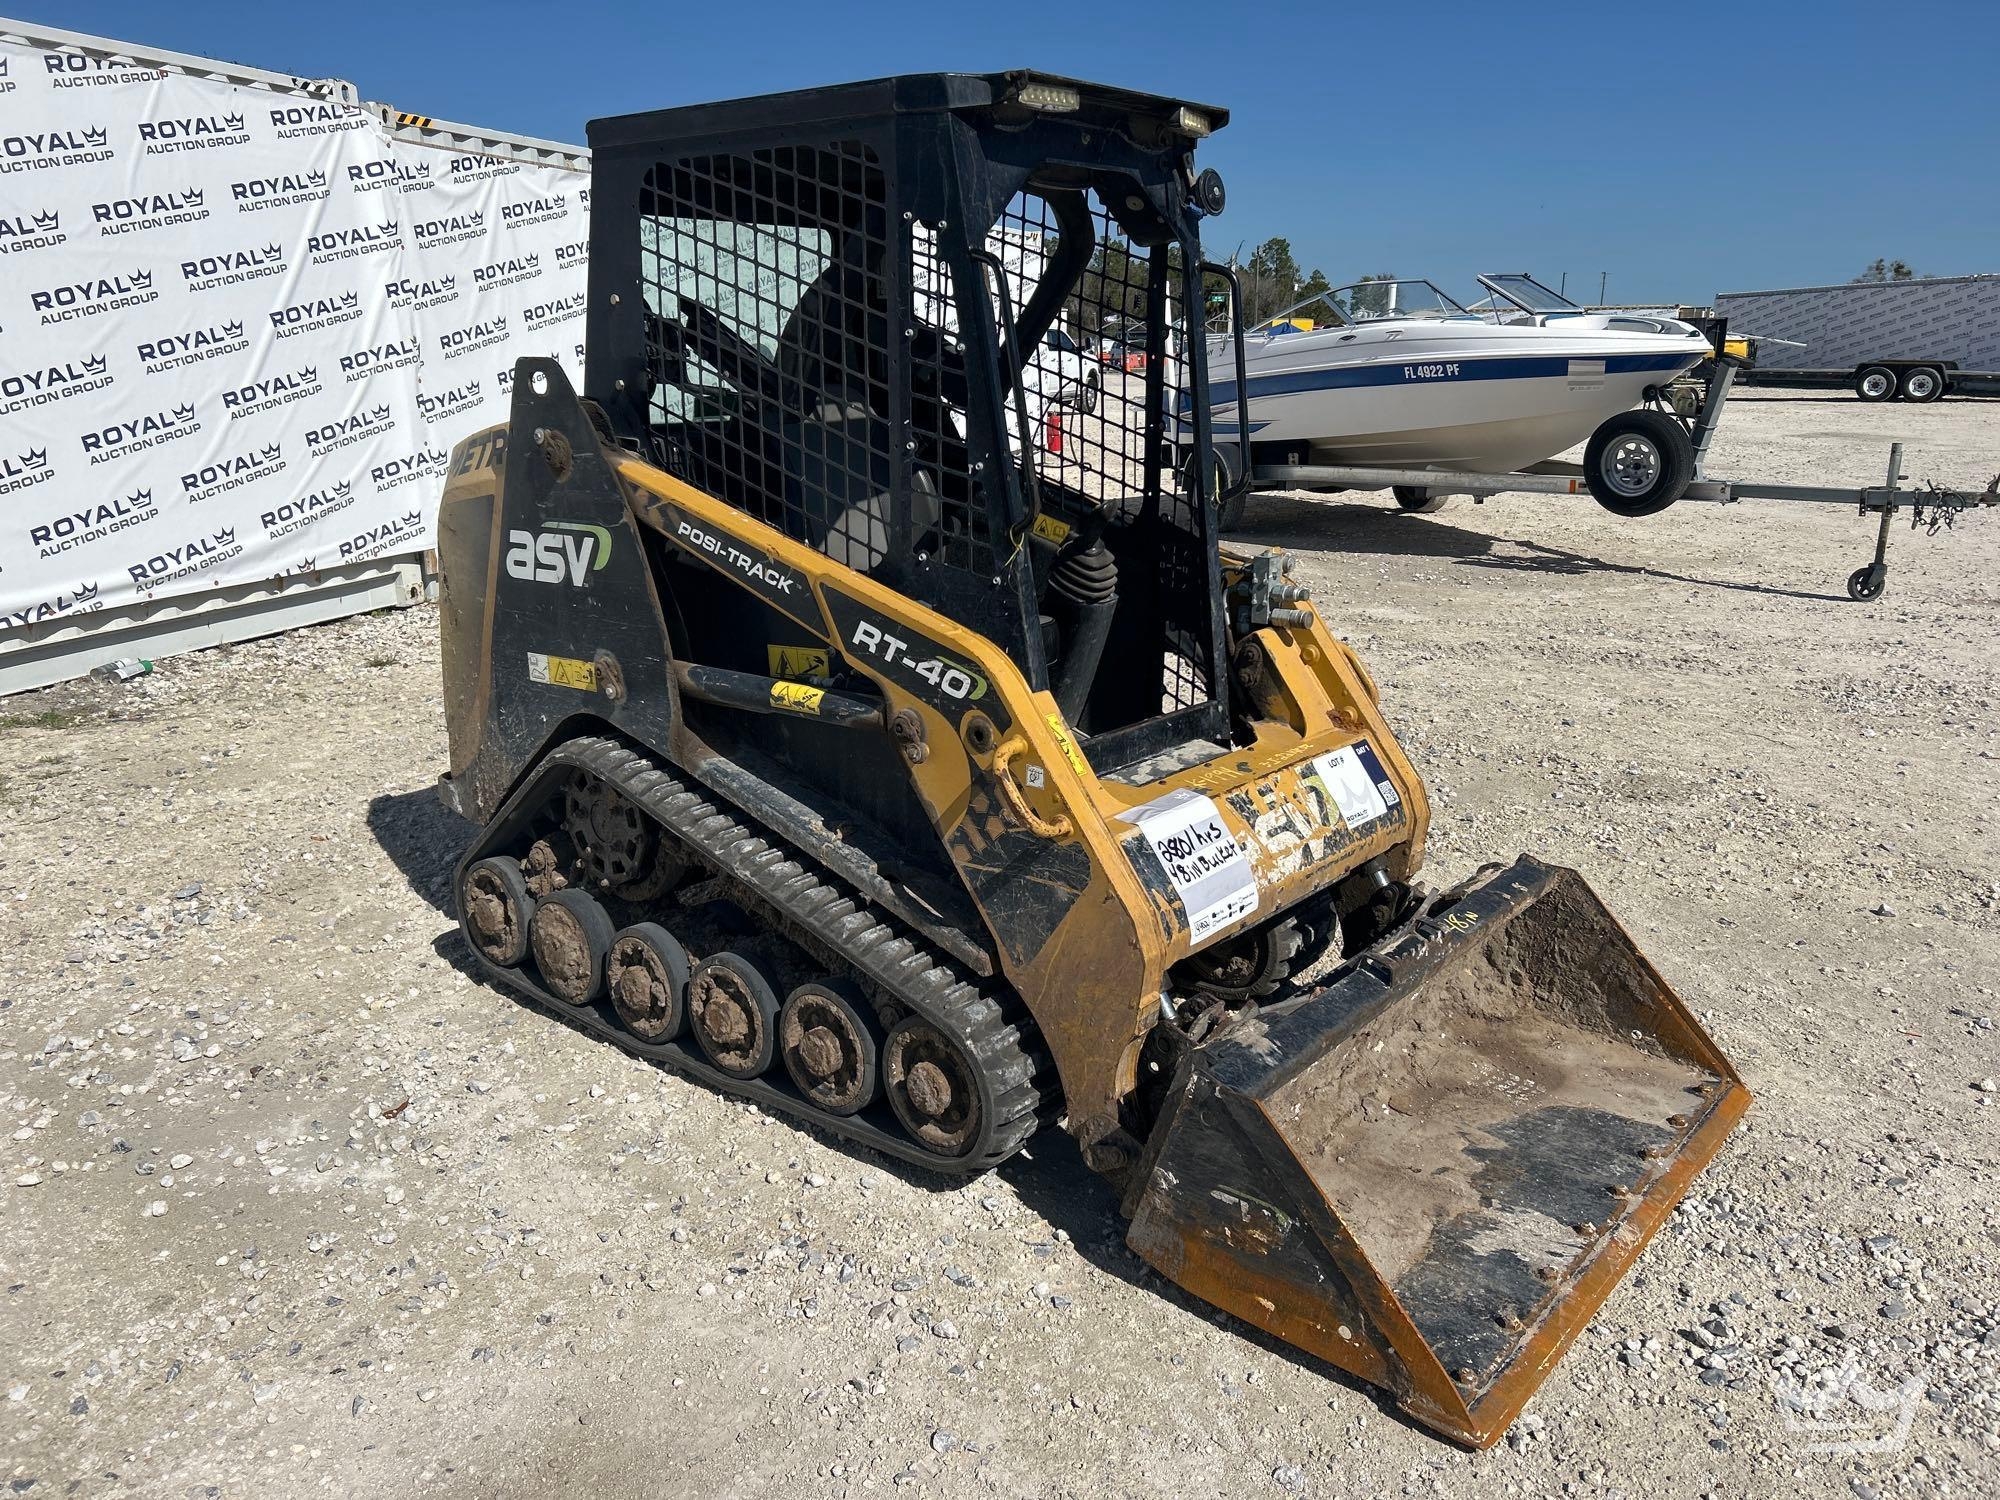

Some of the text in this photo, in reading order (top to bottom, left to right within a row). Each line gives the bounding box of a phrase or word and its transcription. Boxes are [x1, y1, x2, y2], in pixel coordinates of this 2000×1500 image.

[53, 70, 168, 88] AUCTION GROUP
[139, 116, 226, 140] ROYAL
[270, 103, 343, 126] ROYAL
[278, 119, 369, 139] AUCTION GROUP
[0, 130, 85, 157] OYAL
[147, 135, 250, 154] AUCTION GROUP
[0, 150, 114, 173] UCTION GROUP
[454, 166, 519, 183] AUCTION GROUP
[231, 174, 309, 199] ROYAL
[403, 181, 434, 193] GROUP
[92, 192, 183, 222] ROYAL
[239, 190, 330, 213] AUCTION GROUP
[502, 199, 553, 219] ROYAL
[102, 210, 209, 236] AUCTION GROUP
[414, 215, 472, 238] ROYAL
[507, 210, 567, 229] AUCTION GROUP
[11, 234, 66, 252] GROUP
[308, 226, 381, 253] ROYAL
[313, 238, 403, 265] AUCTION GROUP
[419, 228, 487, 250] AUCTION GROUP
[181, 248, 264, 279] ROYAL
[473, 257, 527, 282] ROYAL
[190, 264, 287, 292] AUCTION GROUP
[479, 269, 542, 292] AUCTION GROUP
[31, 274, 131, 311] ROYAL
[423, 292, 458, 308] GROUP
[41, 292, 158, 325] AUCTION GROUP
[269, 296, 343, 326] ROYAL
[524, 297, 574, 322] ROYAL
[528, 307, 588, 332] AUCTION GROUP
[277, 310, 363, 339] AUCTION GROUP
[440, 322, 495, 348] ROYAL
[137, 326, 225, 362] ROYAL
[340, 341, 413, 372] ROYAL
[445, 333, 509, 360] AUCTION GROUP
[147, 341, 249, 375] AUCTION GROUP
[1404, 364, 1460, 379] FL 4922 PF
[2, 360, 85, 396] OYAL
[347, 364, 393, 383] AUCTION
[0, 376, 113, 415] UCTION GROUP
[222, 372, 300, 408] ROYAL
[231, 385, 322, 420] AUCTION GROUP
[456, 397, 483, 413] GROUP
[81, 410, 176, 452] ROYAL
[305, 410, 374, 447] ROYAL
[312, 421, 395, 458] AUCTION GROUP
[91, 423, 201, 465] AUCTION GROUP
[0, 470, 54, 494] GROUP
[181, 450, 264, 491] ROYAL
[190, 462, 286, 504] AUCTION GROUP
[378, 470, 423, 493] AUCTION
[30, 497, 132, 546] ROYAL
[261, 490, 330, 529] ROYAL
[270, 497, 354, 540] AUCTION GROUP
[41, 509, 158, 559] AUCTION GROUP
[339, 522, 403, 557] ROYAL
[389, 527, 425, 546] GROUP
[128, 535, 218, 583] ROYAL
[137, 545, 242, 594] AUCTION GROUP
[677, 521, 793, 595] POSI-TRACK
[852, 621, 972, 700] RT-40
[1328, 757, 1339, 768] LOT
